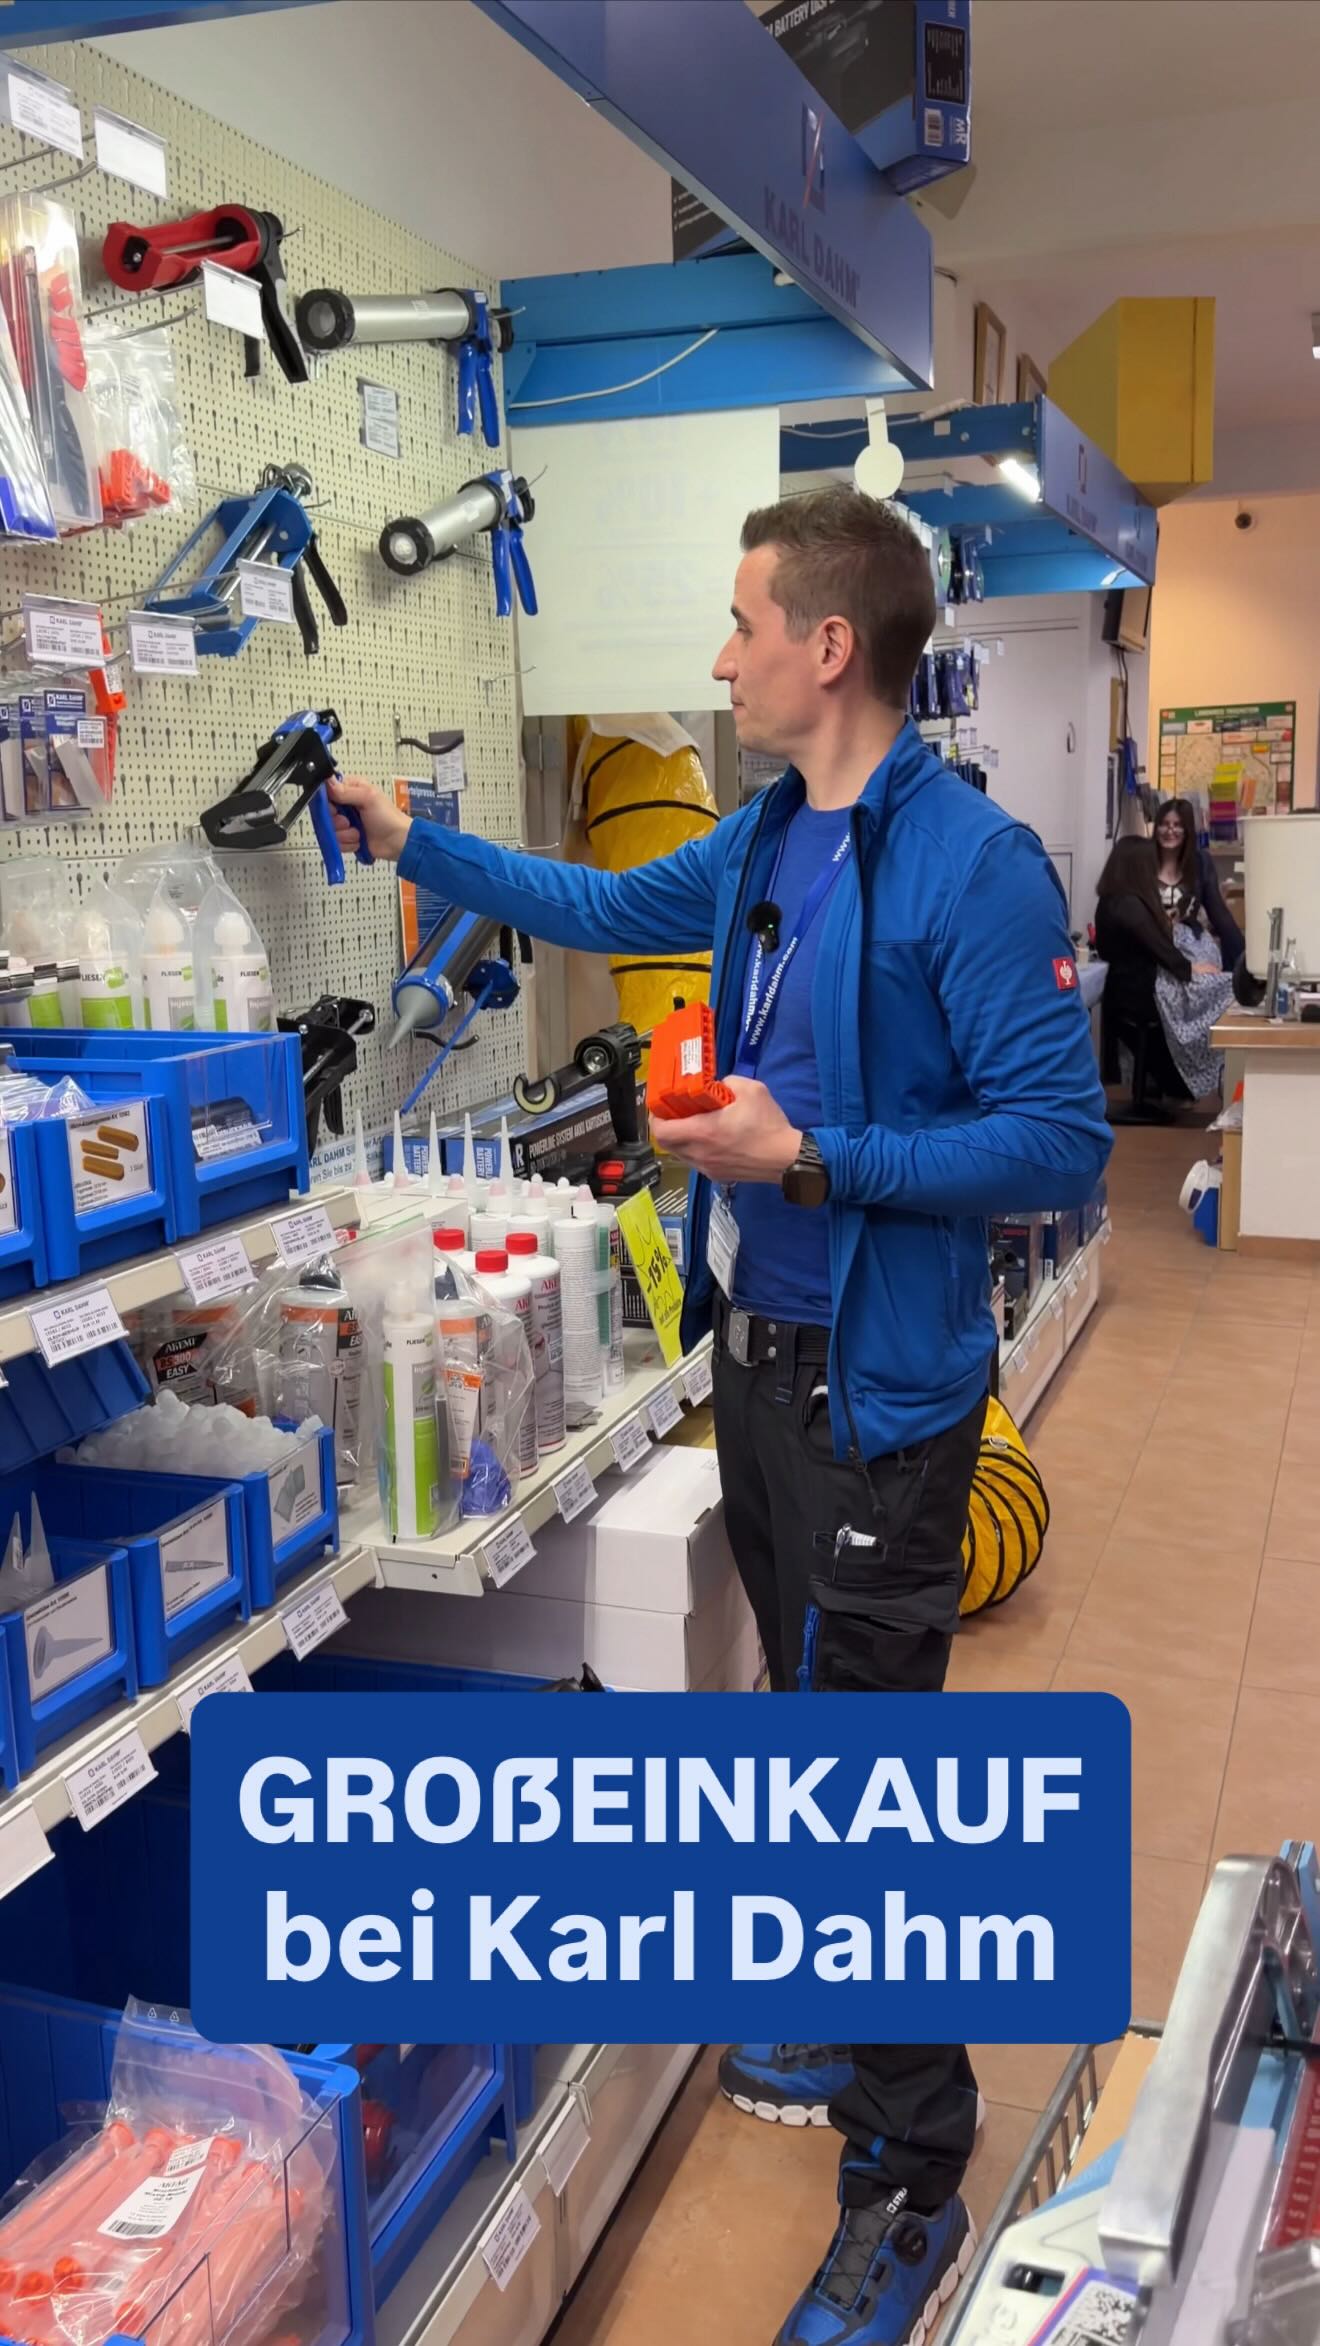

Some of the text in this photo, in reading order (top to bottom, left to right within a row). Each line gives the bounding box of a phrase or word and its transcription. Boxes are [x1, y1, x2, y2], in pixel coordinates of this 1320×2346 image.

[749, 936, 798, 1046] www.karldahm.com
[323, 1147, 346, 1163] DAHM
[164, 1337, 196, 1353] AKEMI
[166, 1365, 189, 1379] EASY
